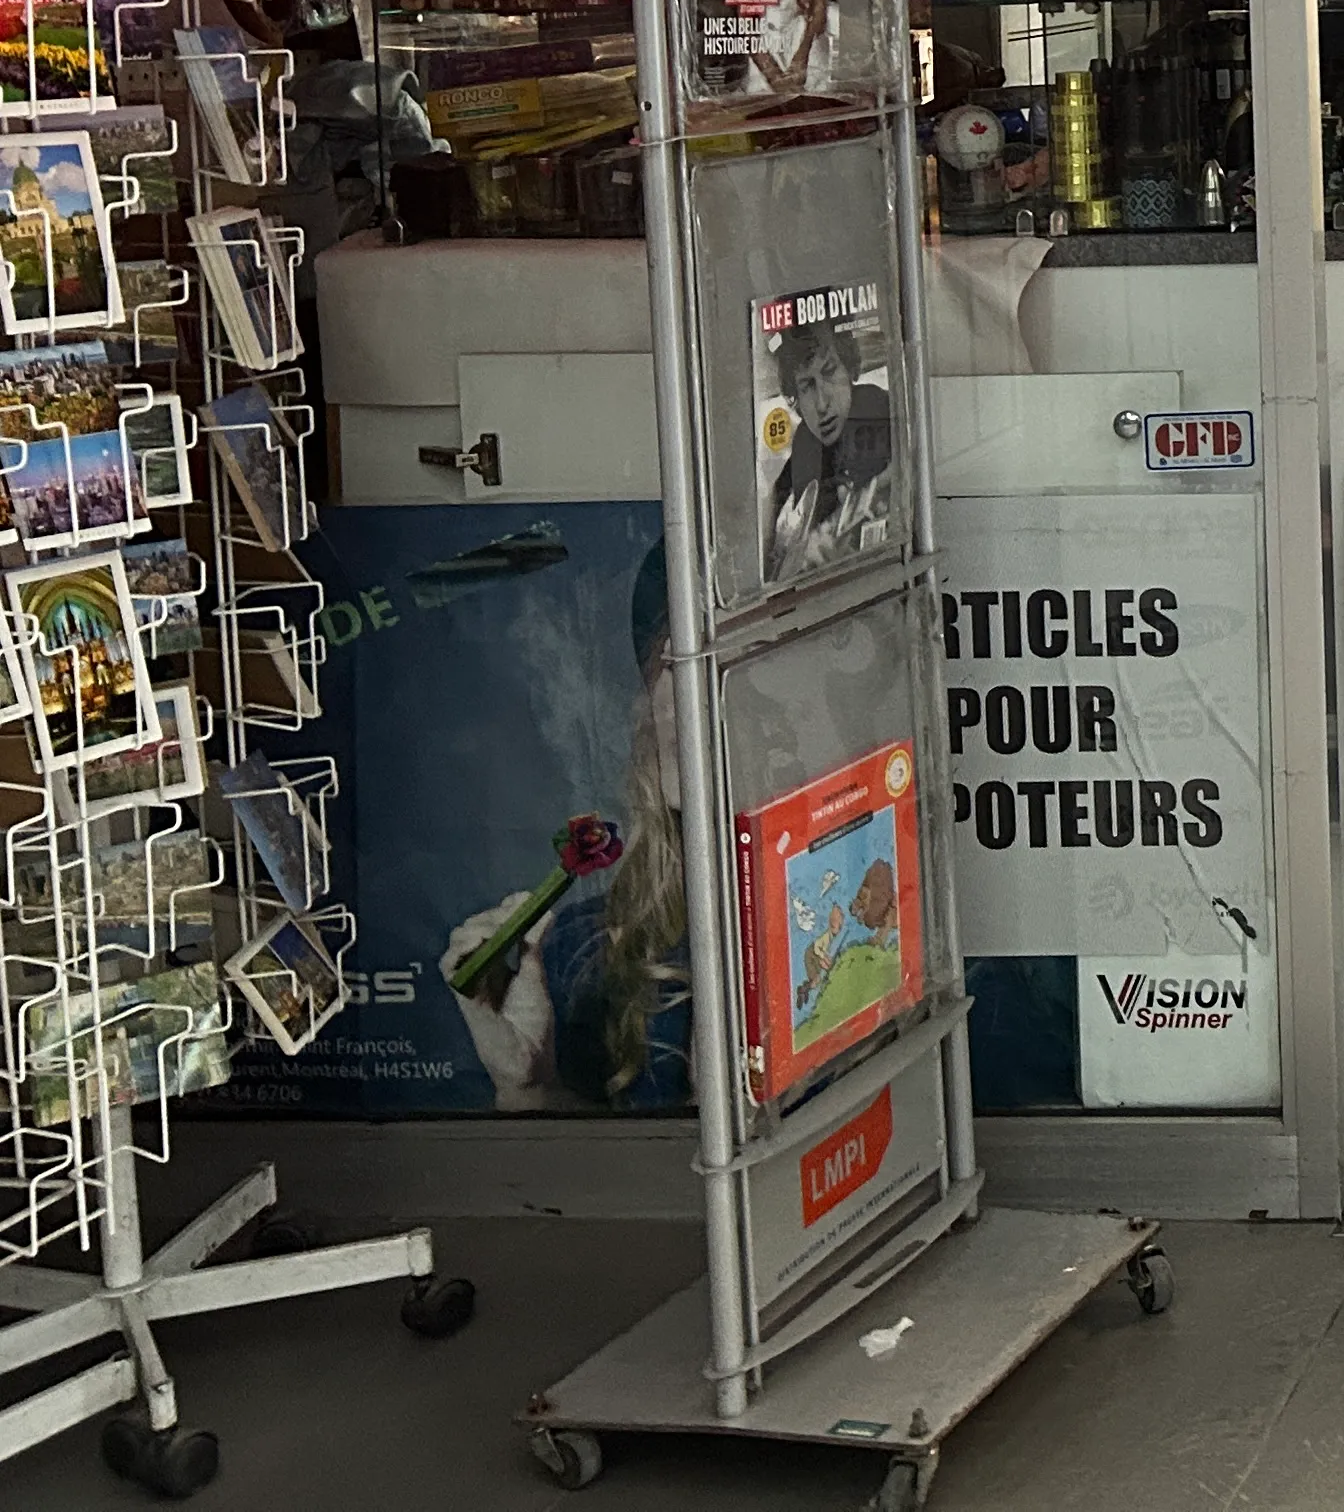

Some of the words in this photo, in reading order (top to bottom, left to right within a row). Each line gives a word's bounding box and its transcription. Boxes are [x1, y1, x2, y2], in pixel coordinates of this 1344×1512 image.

[704, 18, 725, 36] UNE
[727, 18, 737, 35] SI
[704, 37, 750, 55] HISTOIRE
[762, 303, 792, 330] LIFE
[797, 293, 825, 325] BOB
[828, 283, 877, 318] DYLAN
[769, 420, 786, 437] 85
[947, 685, 1118, 754] POUR
[1096, 974, 1247, 1025] VISION
[1135, 1007, 1234, 1032] Spinner
[336, 1038, 416, 1056] François,
[375, 1062, 453, 1080] H4S1W6
[811, 1133, 867, 1203] LMPI
